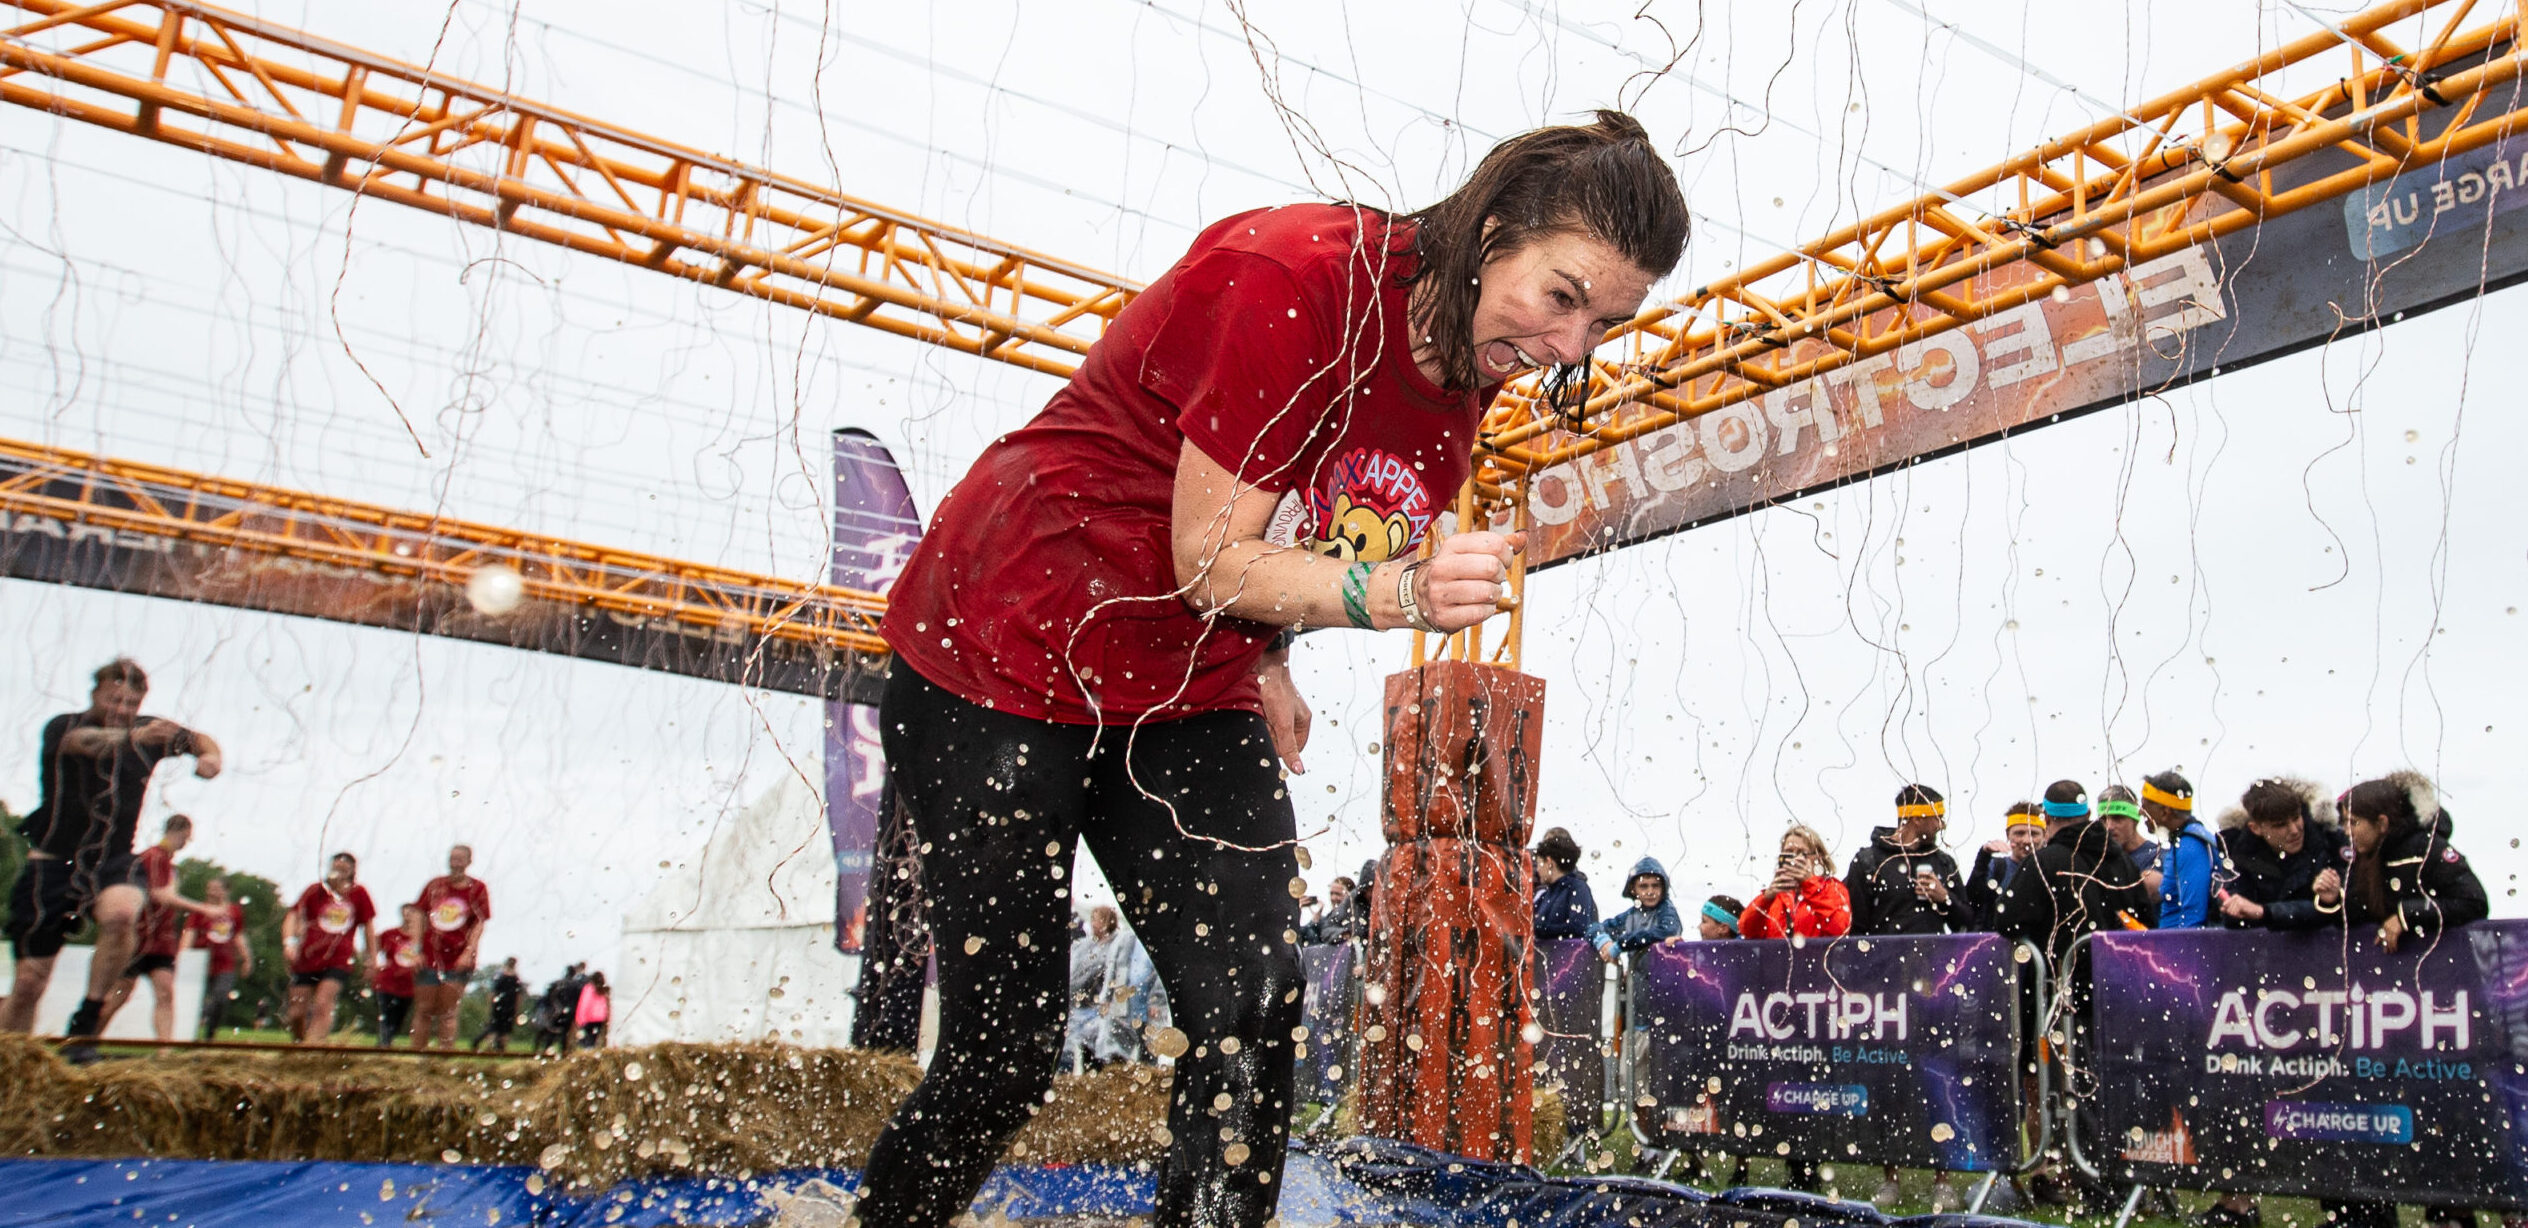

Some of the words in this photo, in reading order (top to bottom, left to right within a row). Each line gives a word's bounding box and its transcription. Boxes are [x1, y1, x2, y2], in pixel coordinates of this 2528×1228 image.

[1727, 1045, 1768, 1060] Drink
[1771, 1045, 1828, 1064] Actiph.
[1832, 1046, 1851, 1063] Be
[1855, 1047, 1912, 1065] Active.
[2206, 1054, 2262, 1074] Dnk
[2355, 1056, 2386, 1078] Be
[2394, 1057, 2478, 1080] Active.
[1841, 1092, 1860, 1106] UP
[2288, 1111, 2369, 1132] CHARGE
[2373, 1114, 2401, 1132] UP
